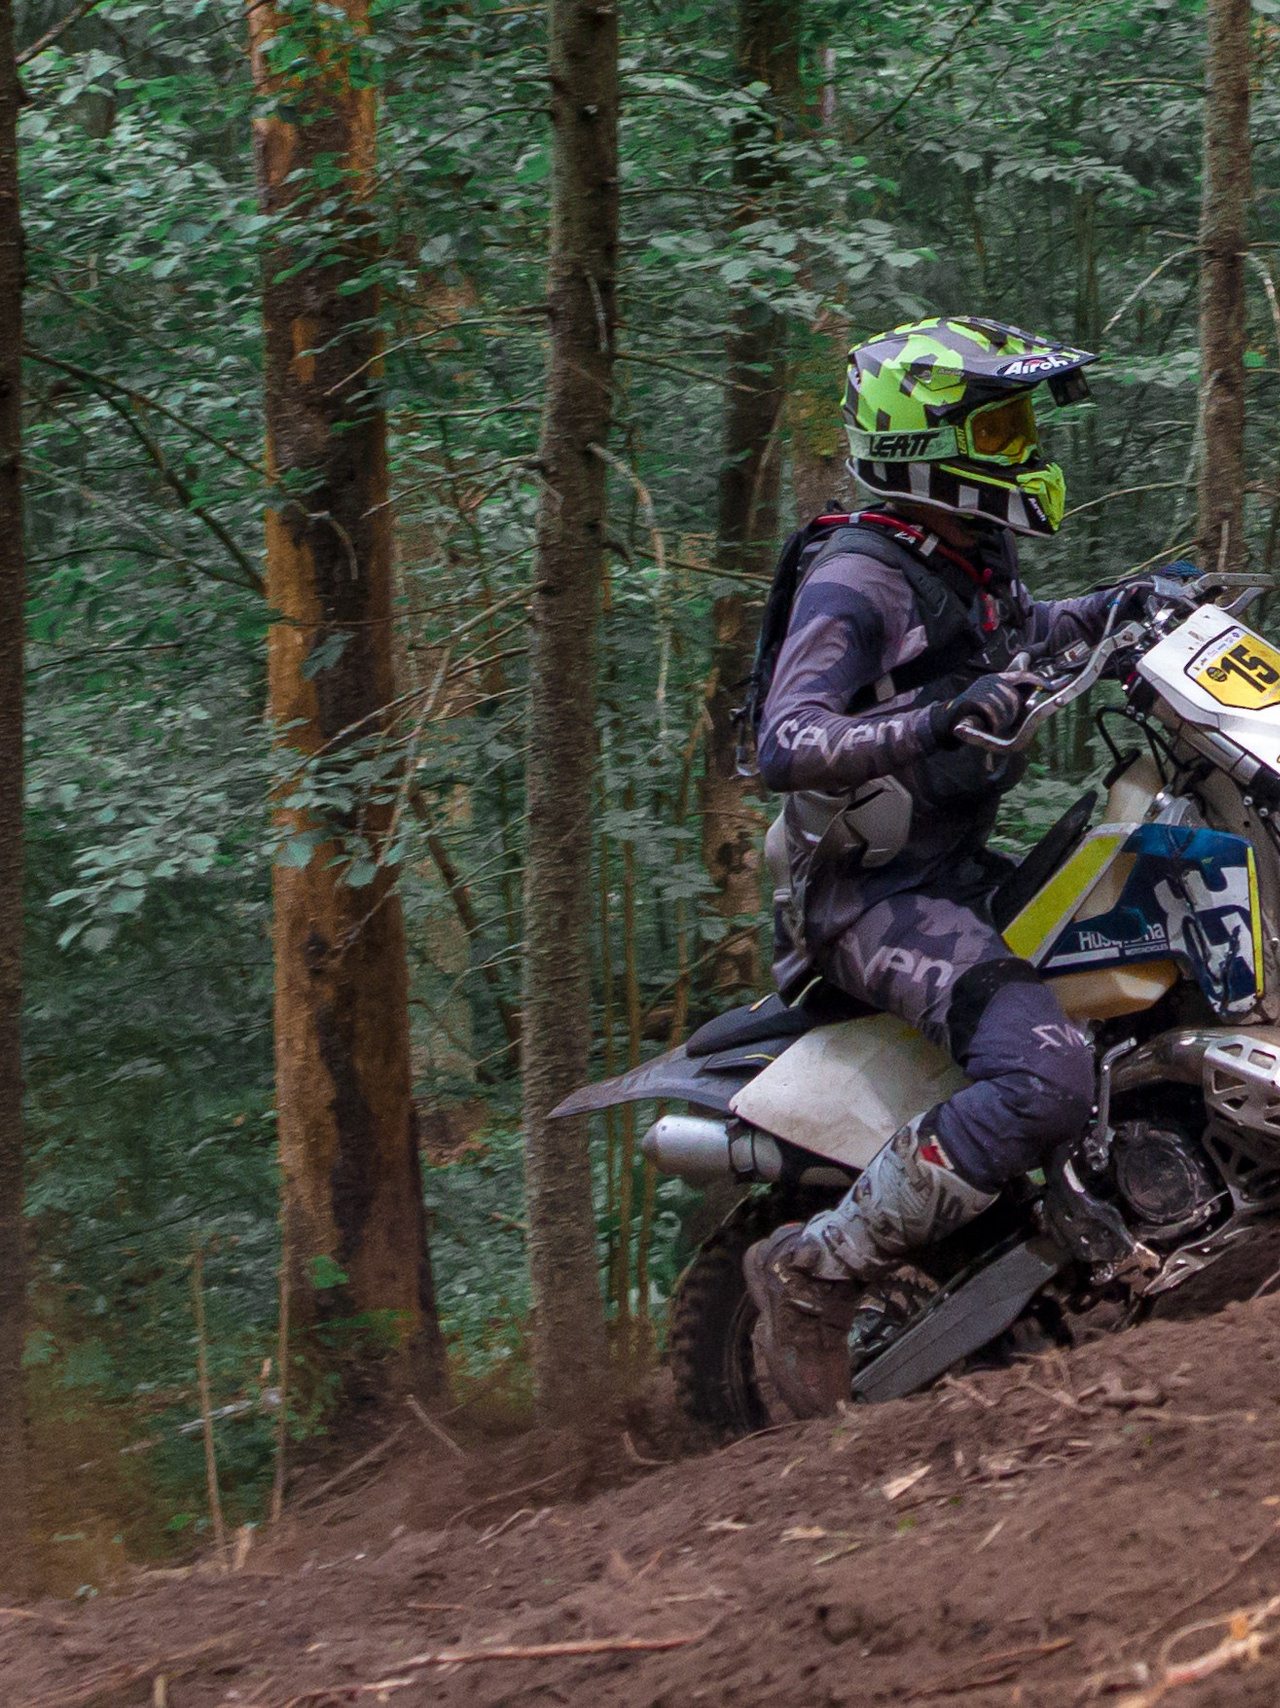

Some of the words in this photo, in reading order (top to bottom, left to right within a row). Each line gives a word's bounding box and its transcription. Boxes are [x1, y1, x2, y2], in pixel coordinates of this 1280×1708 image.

[1004, 356, 1069, 376] Airoh
[869, 432, 940, 457] LEATT
[1221, 644, 1280, 693] 15
